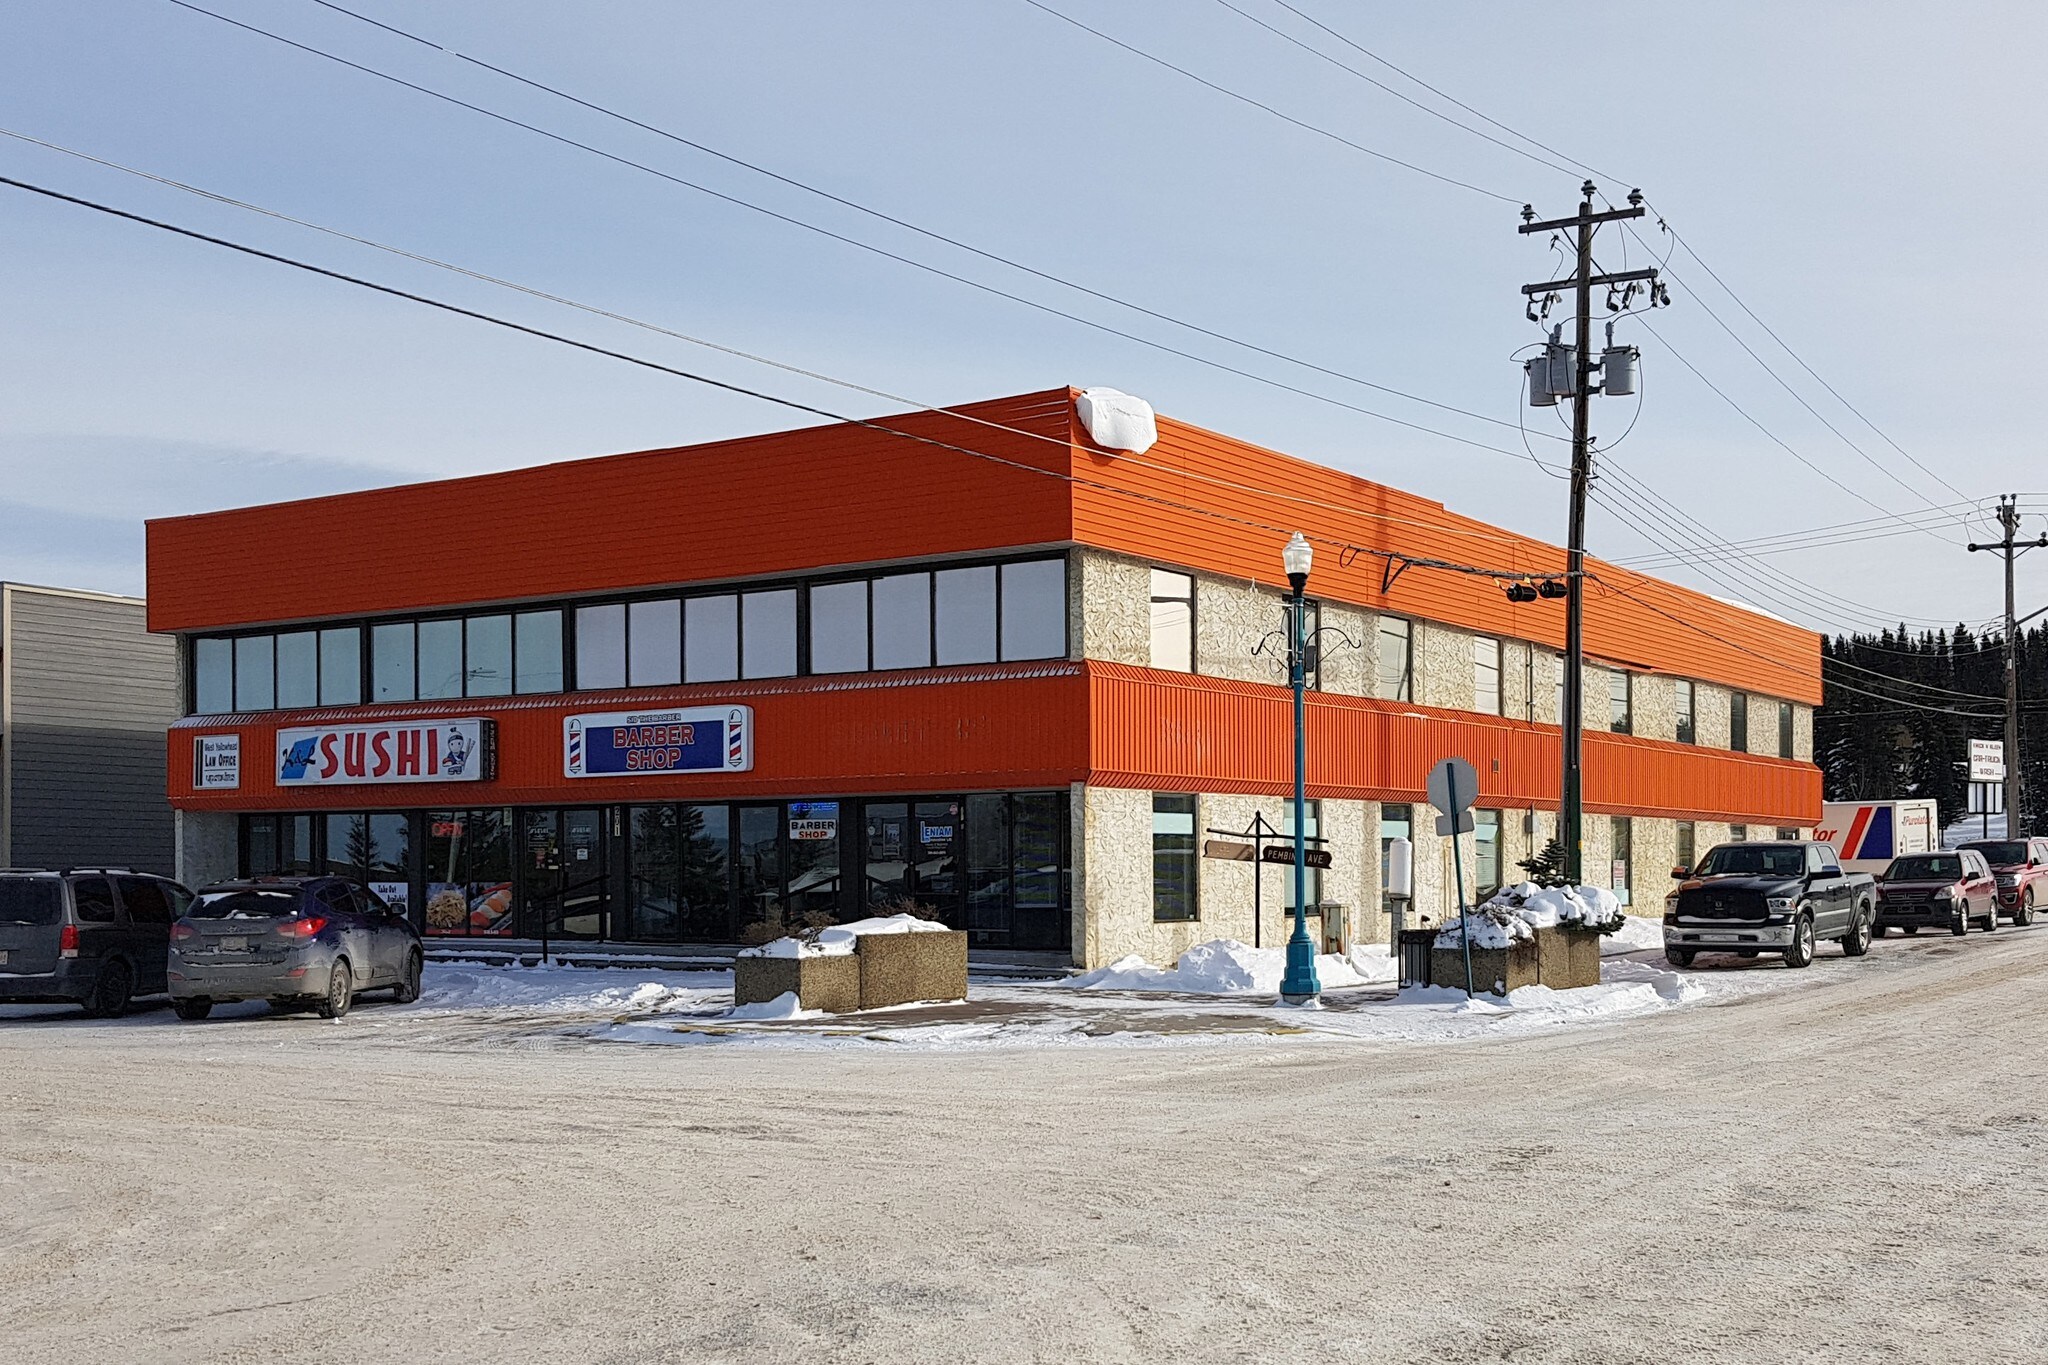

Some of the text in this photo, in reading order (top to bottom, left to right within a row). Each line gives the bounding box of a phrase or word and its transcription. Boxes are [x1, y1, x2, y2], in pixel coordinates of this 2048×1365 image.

[653, 713, 682, 722] BARBER
[613, 725, 695, 748] BARBER
[205, 754, 236, 767] LAW OFFICE
[320, 728, 438, 779] SUSHI
[626, 748, 682, 770] SHOP
[432, 822, 464, 837] OPEN
[791, 821, 834, 830] BARBER
[1267, 850, 1324, 864] PEMBIN AVE
